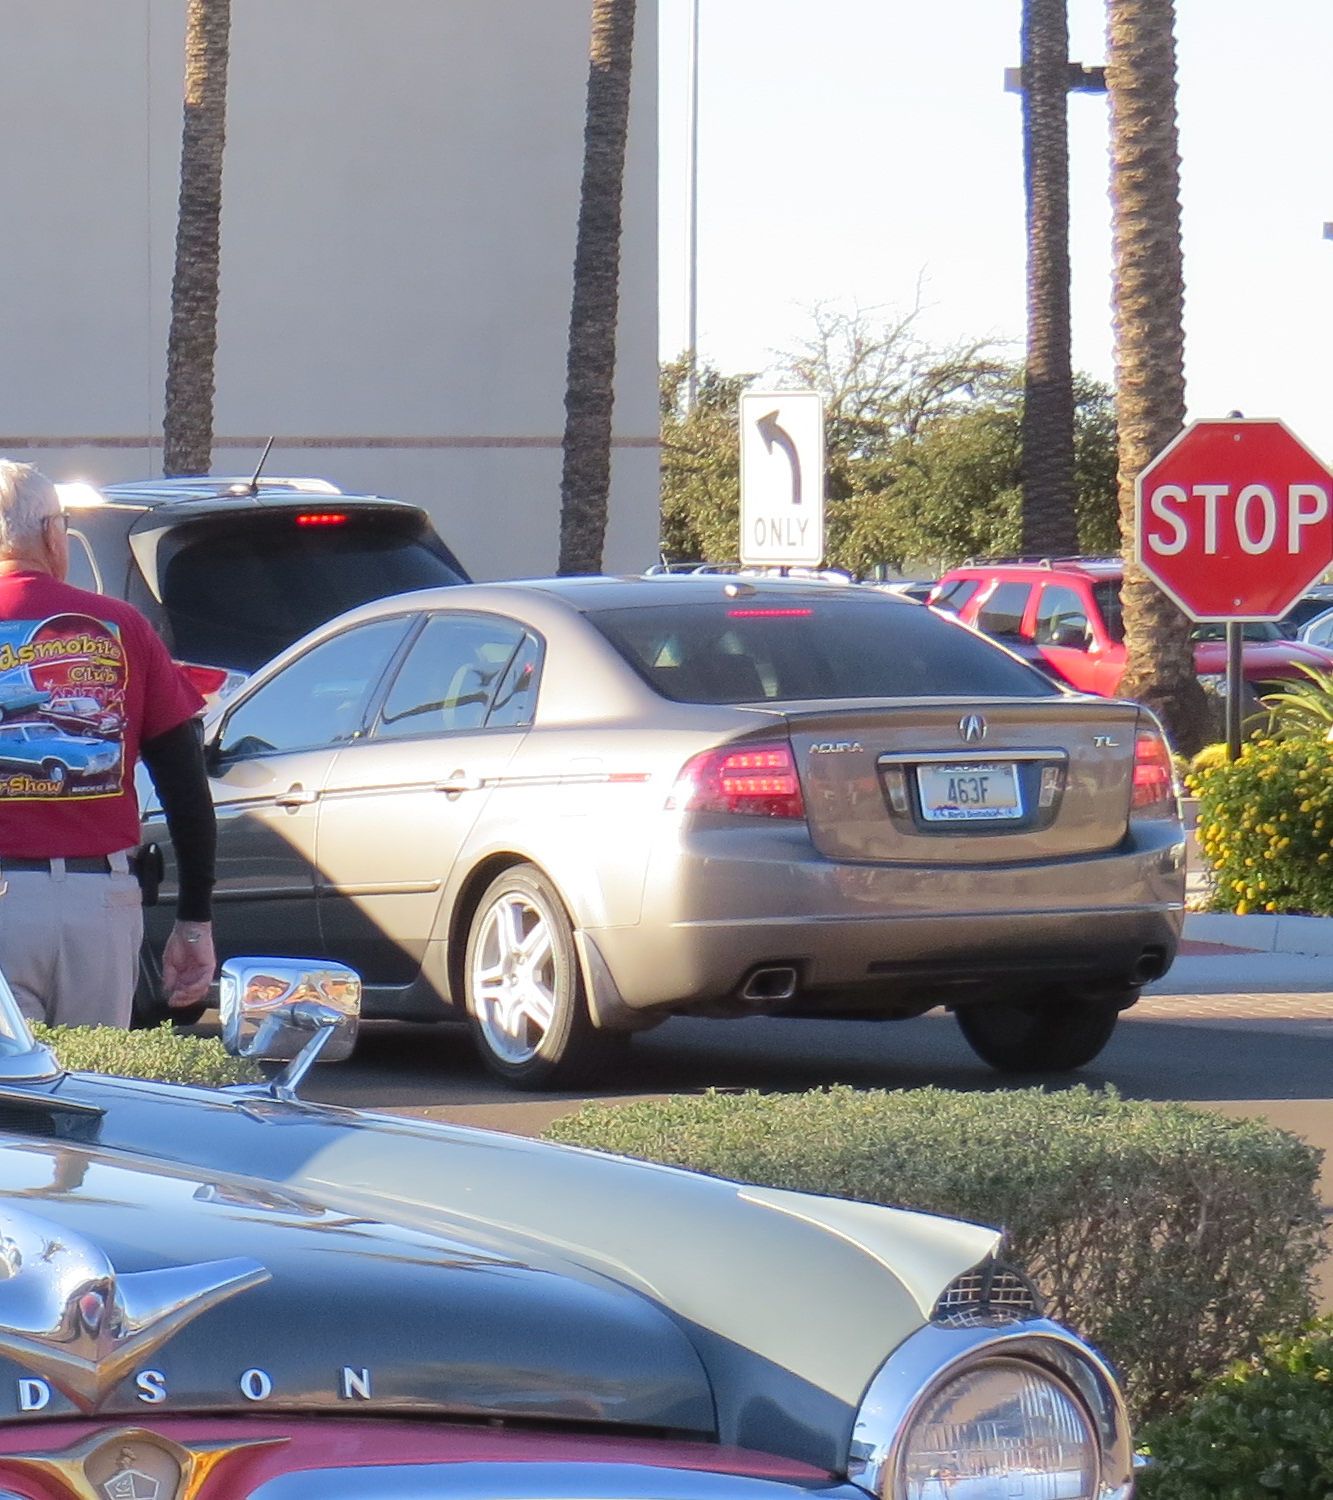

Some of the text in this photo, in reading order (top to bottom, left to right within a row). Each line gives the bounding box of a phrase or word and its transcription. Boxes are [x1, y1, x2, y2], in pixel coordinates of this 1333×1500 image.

[1148, 484, 1329, 556] STOP
[754, 517, 809, 547] ONLY
[69, 666, 118, 684] Club
[808, 742, 864, 754] ACURA
[1093, 735, 1120, 748] TL
[9, 773, 63, 795] Show
